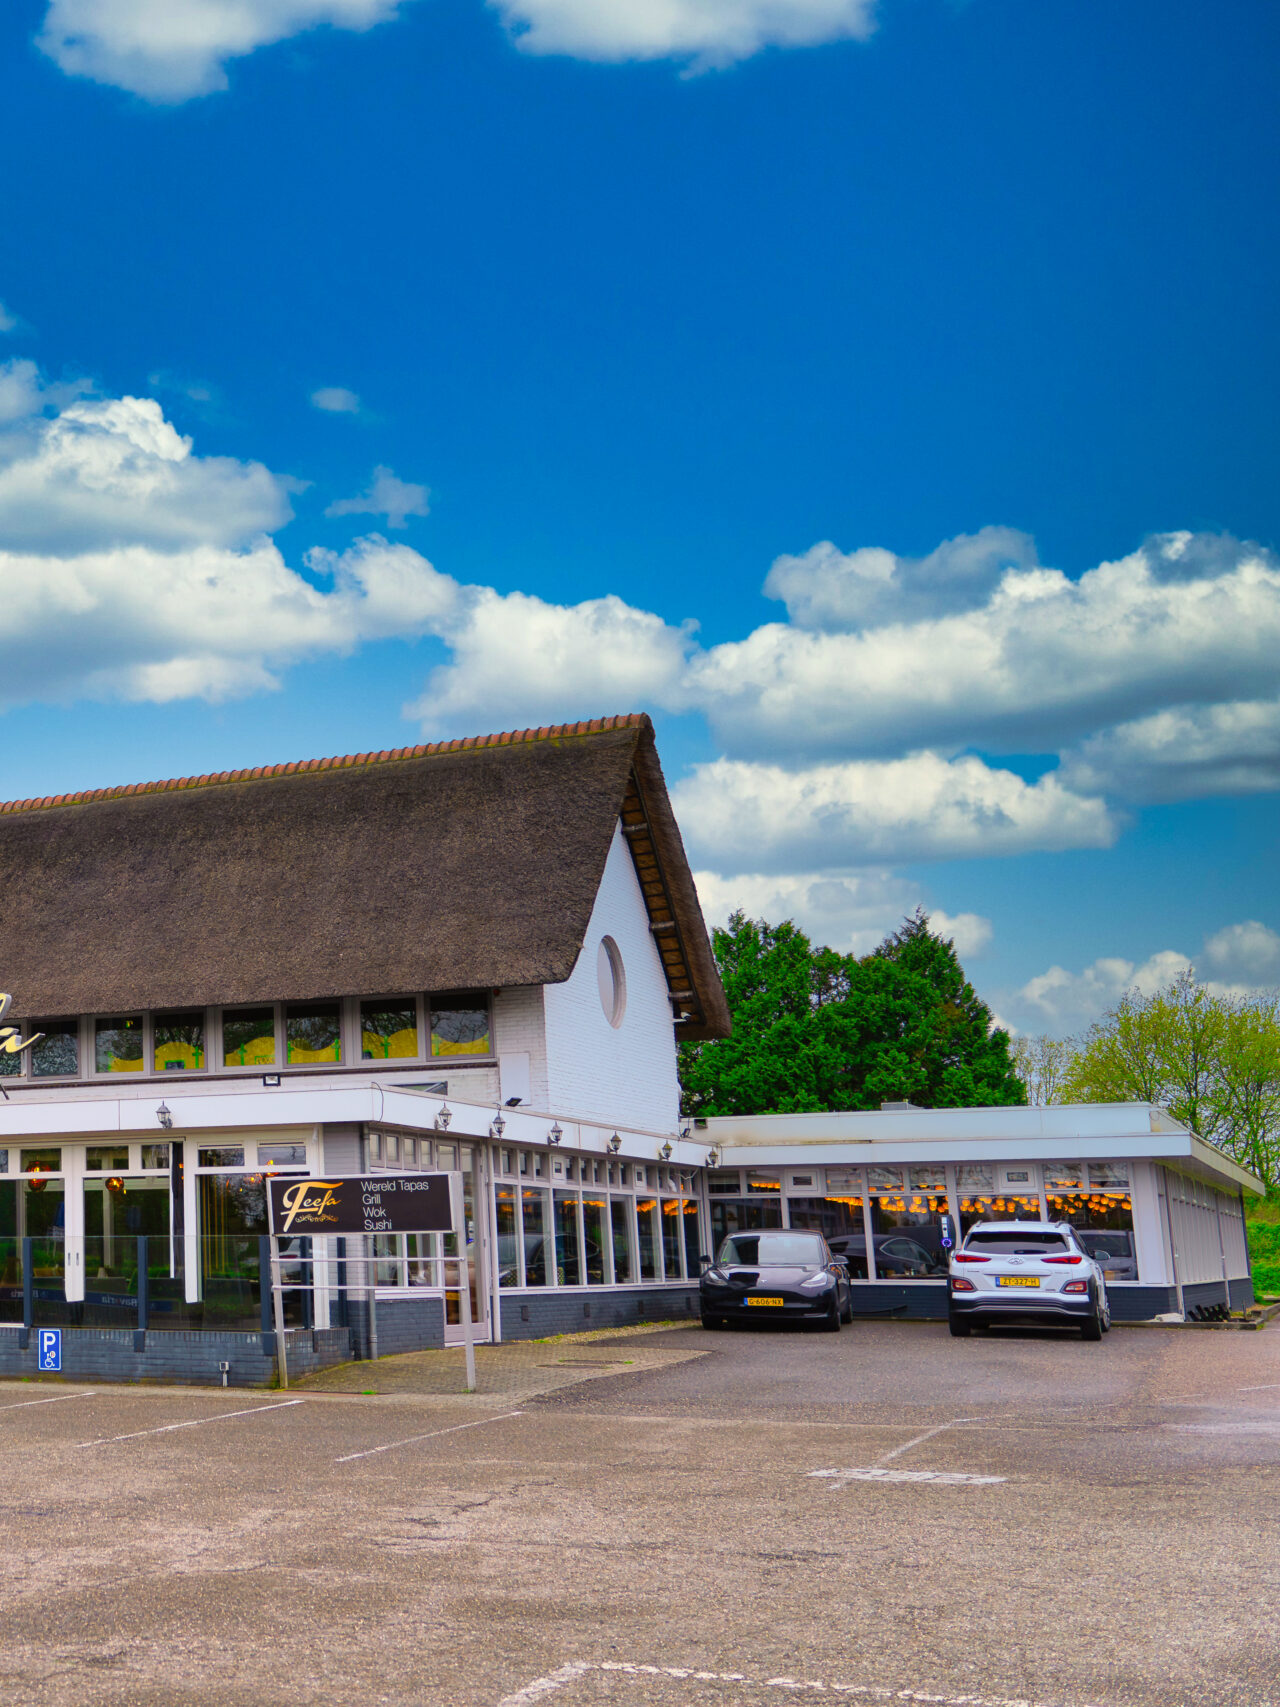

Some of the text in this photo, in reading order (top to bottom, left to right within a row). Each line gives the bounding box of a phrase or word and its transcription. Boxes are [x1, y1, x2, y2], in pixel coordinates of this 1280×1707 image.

[360, 1179, 430, 1193] Wereld Tapas
[362, 1193, 381, 1205] Grill
[280, 1181, 344, 1233] Feefa
[363, 1206, 386, 1218] Wok
[364, 1219, 393, 1231] Sushi
[1002, 1277, 1038, 1286] ZT-327-H
[43, 1332, 56, 1353] P
